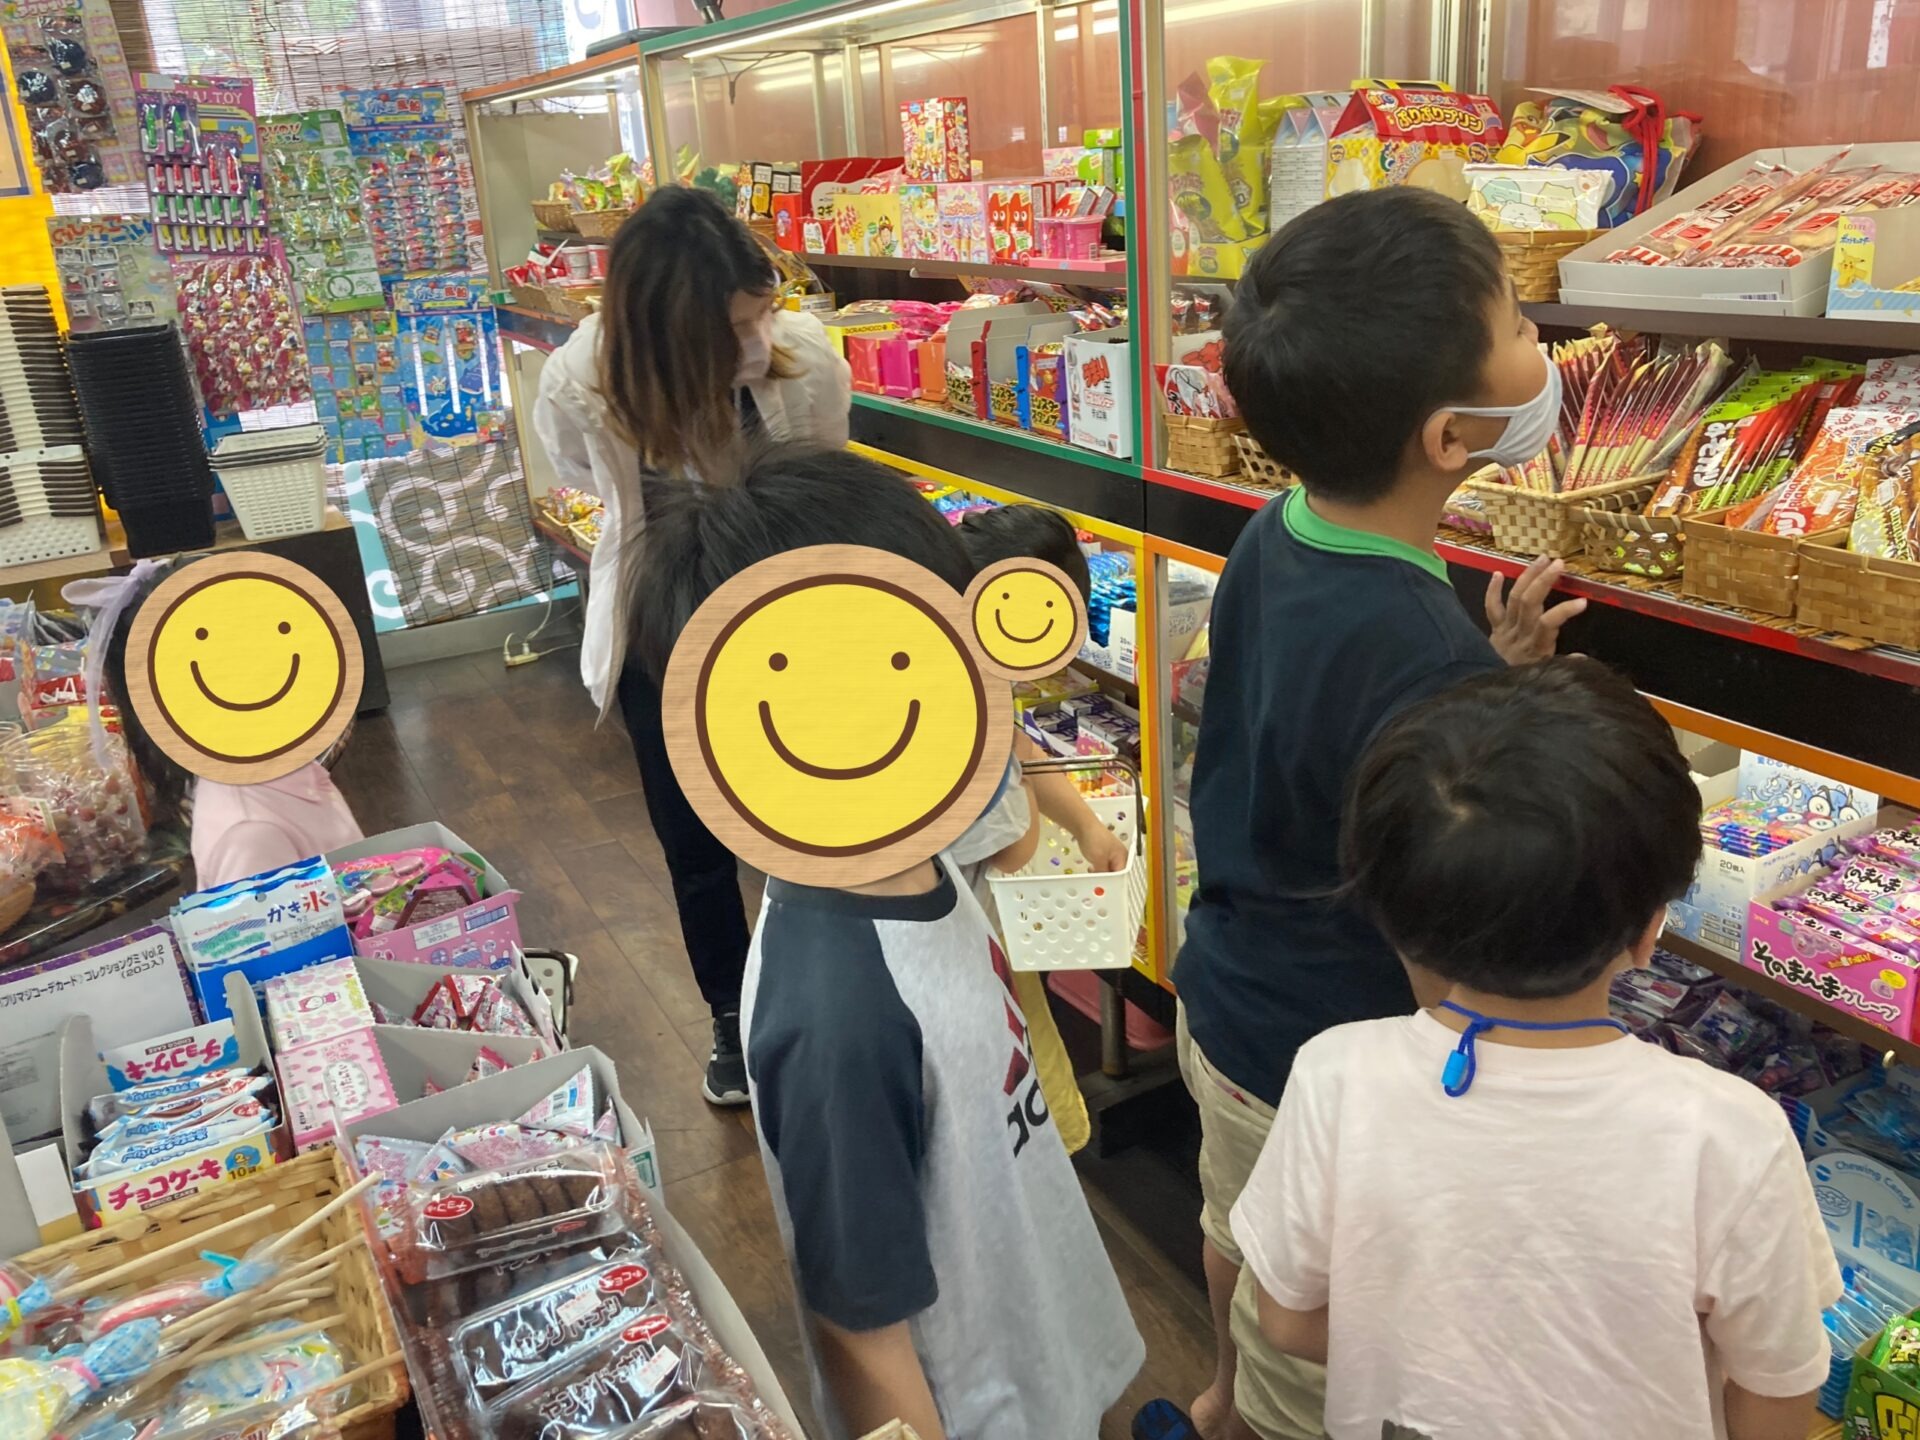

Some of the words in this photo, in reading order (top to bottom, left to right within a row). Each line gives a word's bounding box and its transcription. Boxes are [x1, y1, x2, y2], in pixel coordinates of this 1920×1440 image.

[268, 890, 330, 924] かき氷
[142, 944, 165, 960] Vol.2
[125, 1038, 222, 1081] チョコケーキ
[108, 1159, 222, 1211] チョコケーキ
[1835, 1160, 1882, 1181] Chewing
